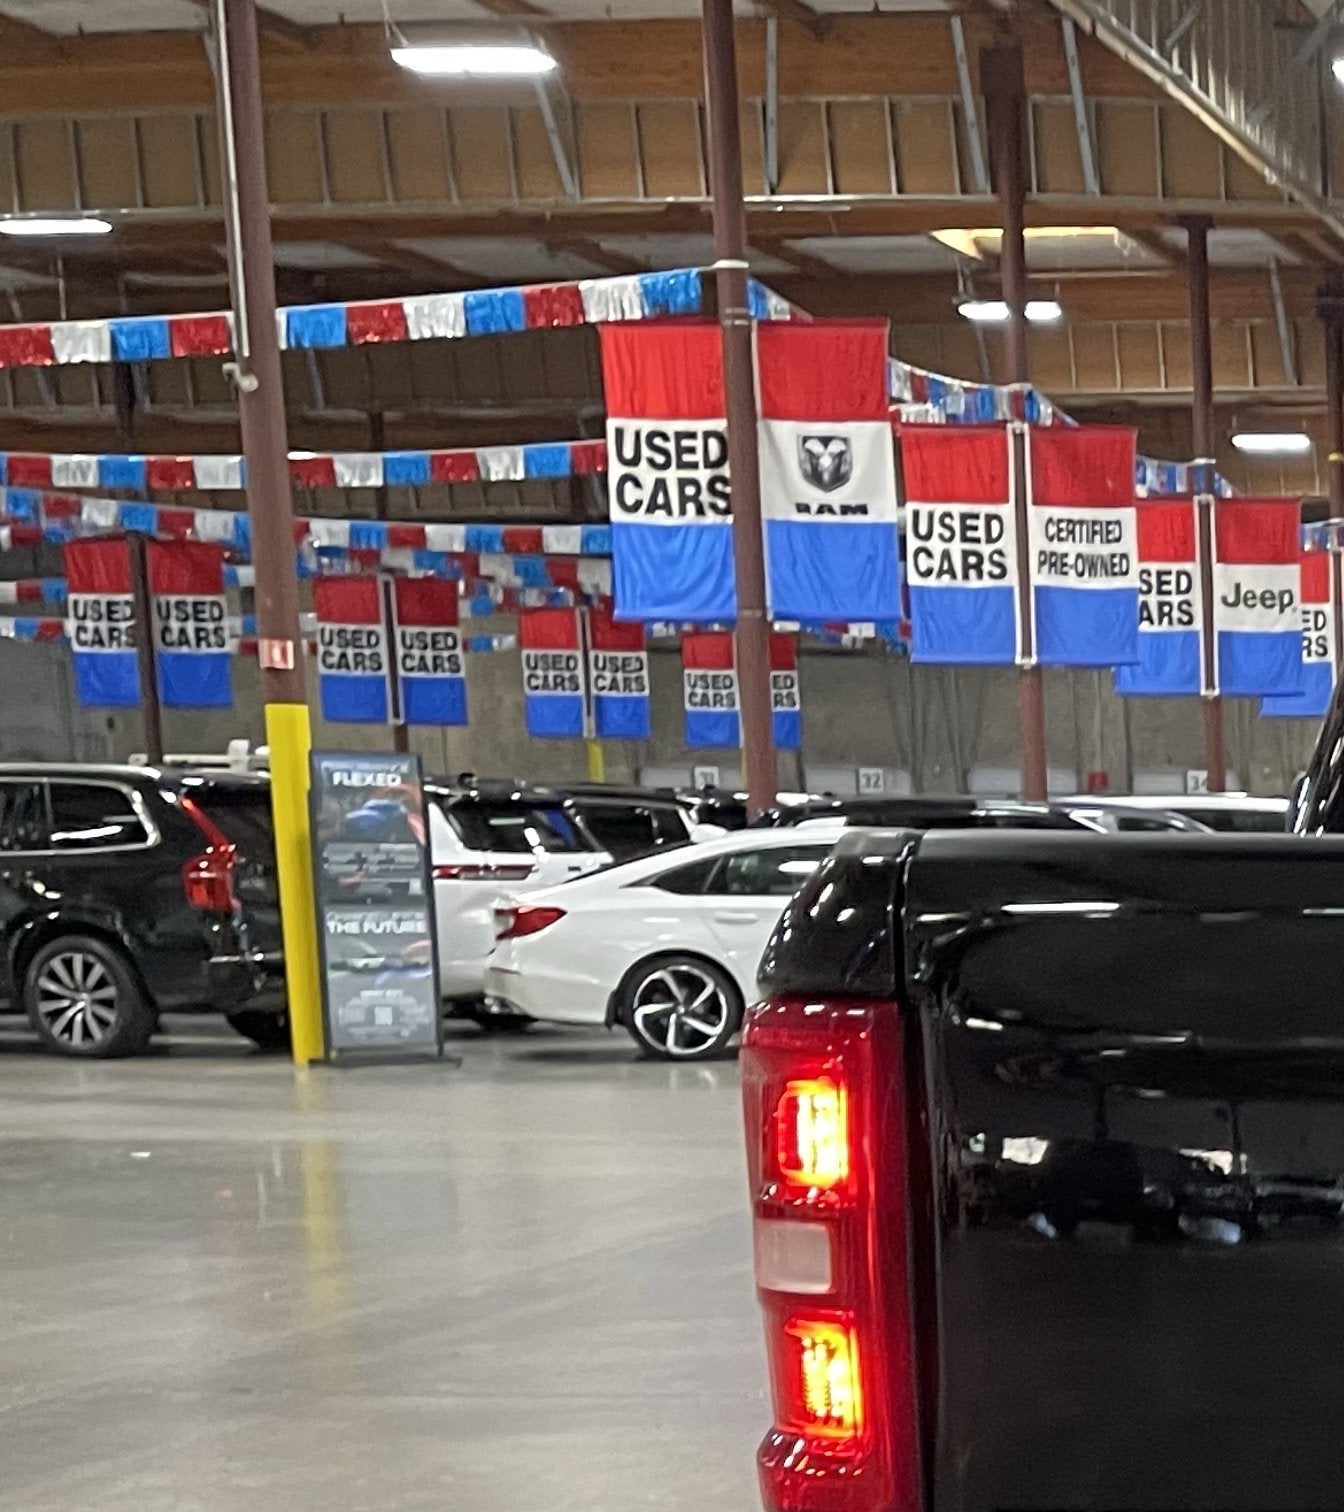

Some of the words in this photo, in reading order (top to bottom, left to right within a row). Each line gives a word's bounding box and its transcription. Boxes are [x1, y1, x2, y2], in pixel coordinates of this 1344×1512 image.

[614, 427, 728, 470] USED
[615, 473, 732, 516] CARS
[912, 509, 1004, 544] USED
[1045, 517, 1122, 544] CERTIFIED
[913, 546, 1007, 580] CARS
[1038, 550, 1130, 578] PRE-OWNED
[1138, 569, 1192, 595] SED
[1221, 582, 1293, 614] Jeep
[73, 600, 135, 622] USED
[156, 600, 223, 622] USED
[1139, 600, 1194, 625] ARS
[1302, 610, 1327, 632] ED
[75, 625, 135, 648] CARS
[160, 625, 226, 648] CARS
[320, 627, 380, 649] USED
[401, 631, 458, 651] USED
[1302, 635, 1328, 657] RS
[322, 650, 382, 672] CARS
[401, 653, 461, 673] CARS
[525, 653, 578, 671] USED
[593, 654, 644, 673] USED
[527, 673, 580, 691] CARS
[594, 674, 646, 693] CARS
[687, 673, 734, 690] USED
[772, 674, 795, 690] ED
[688, 692, 736, 707] CARS
[773, 691, 797, 707] RS
